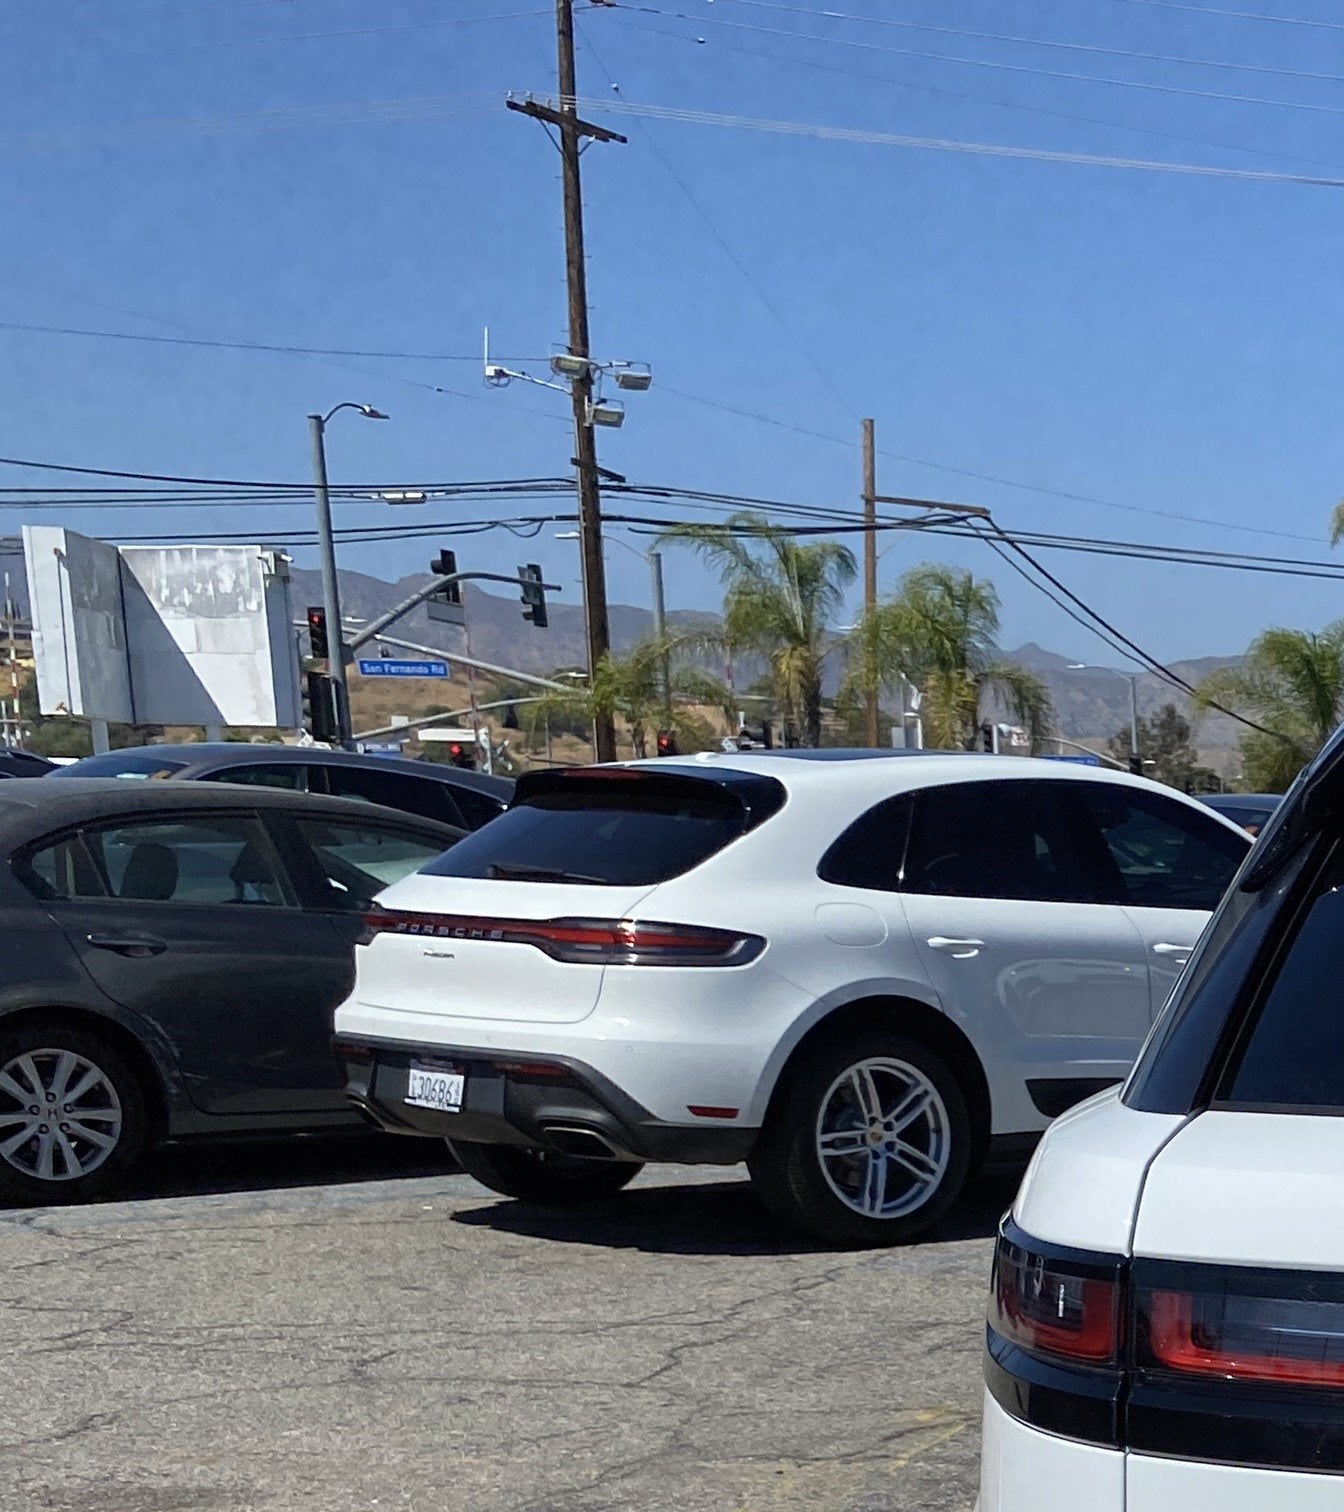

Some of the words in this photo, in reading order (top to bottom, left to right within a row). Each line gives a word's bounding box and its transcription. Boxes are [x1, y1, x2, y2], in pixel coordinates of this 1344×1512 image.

[363, 663, 382, 674] San
[384, 663, 429, 675] Fernando
[431, 664, 445, 675] Rd
[398, 922, 504, 939] PORSCHE
